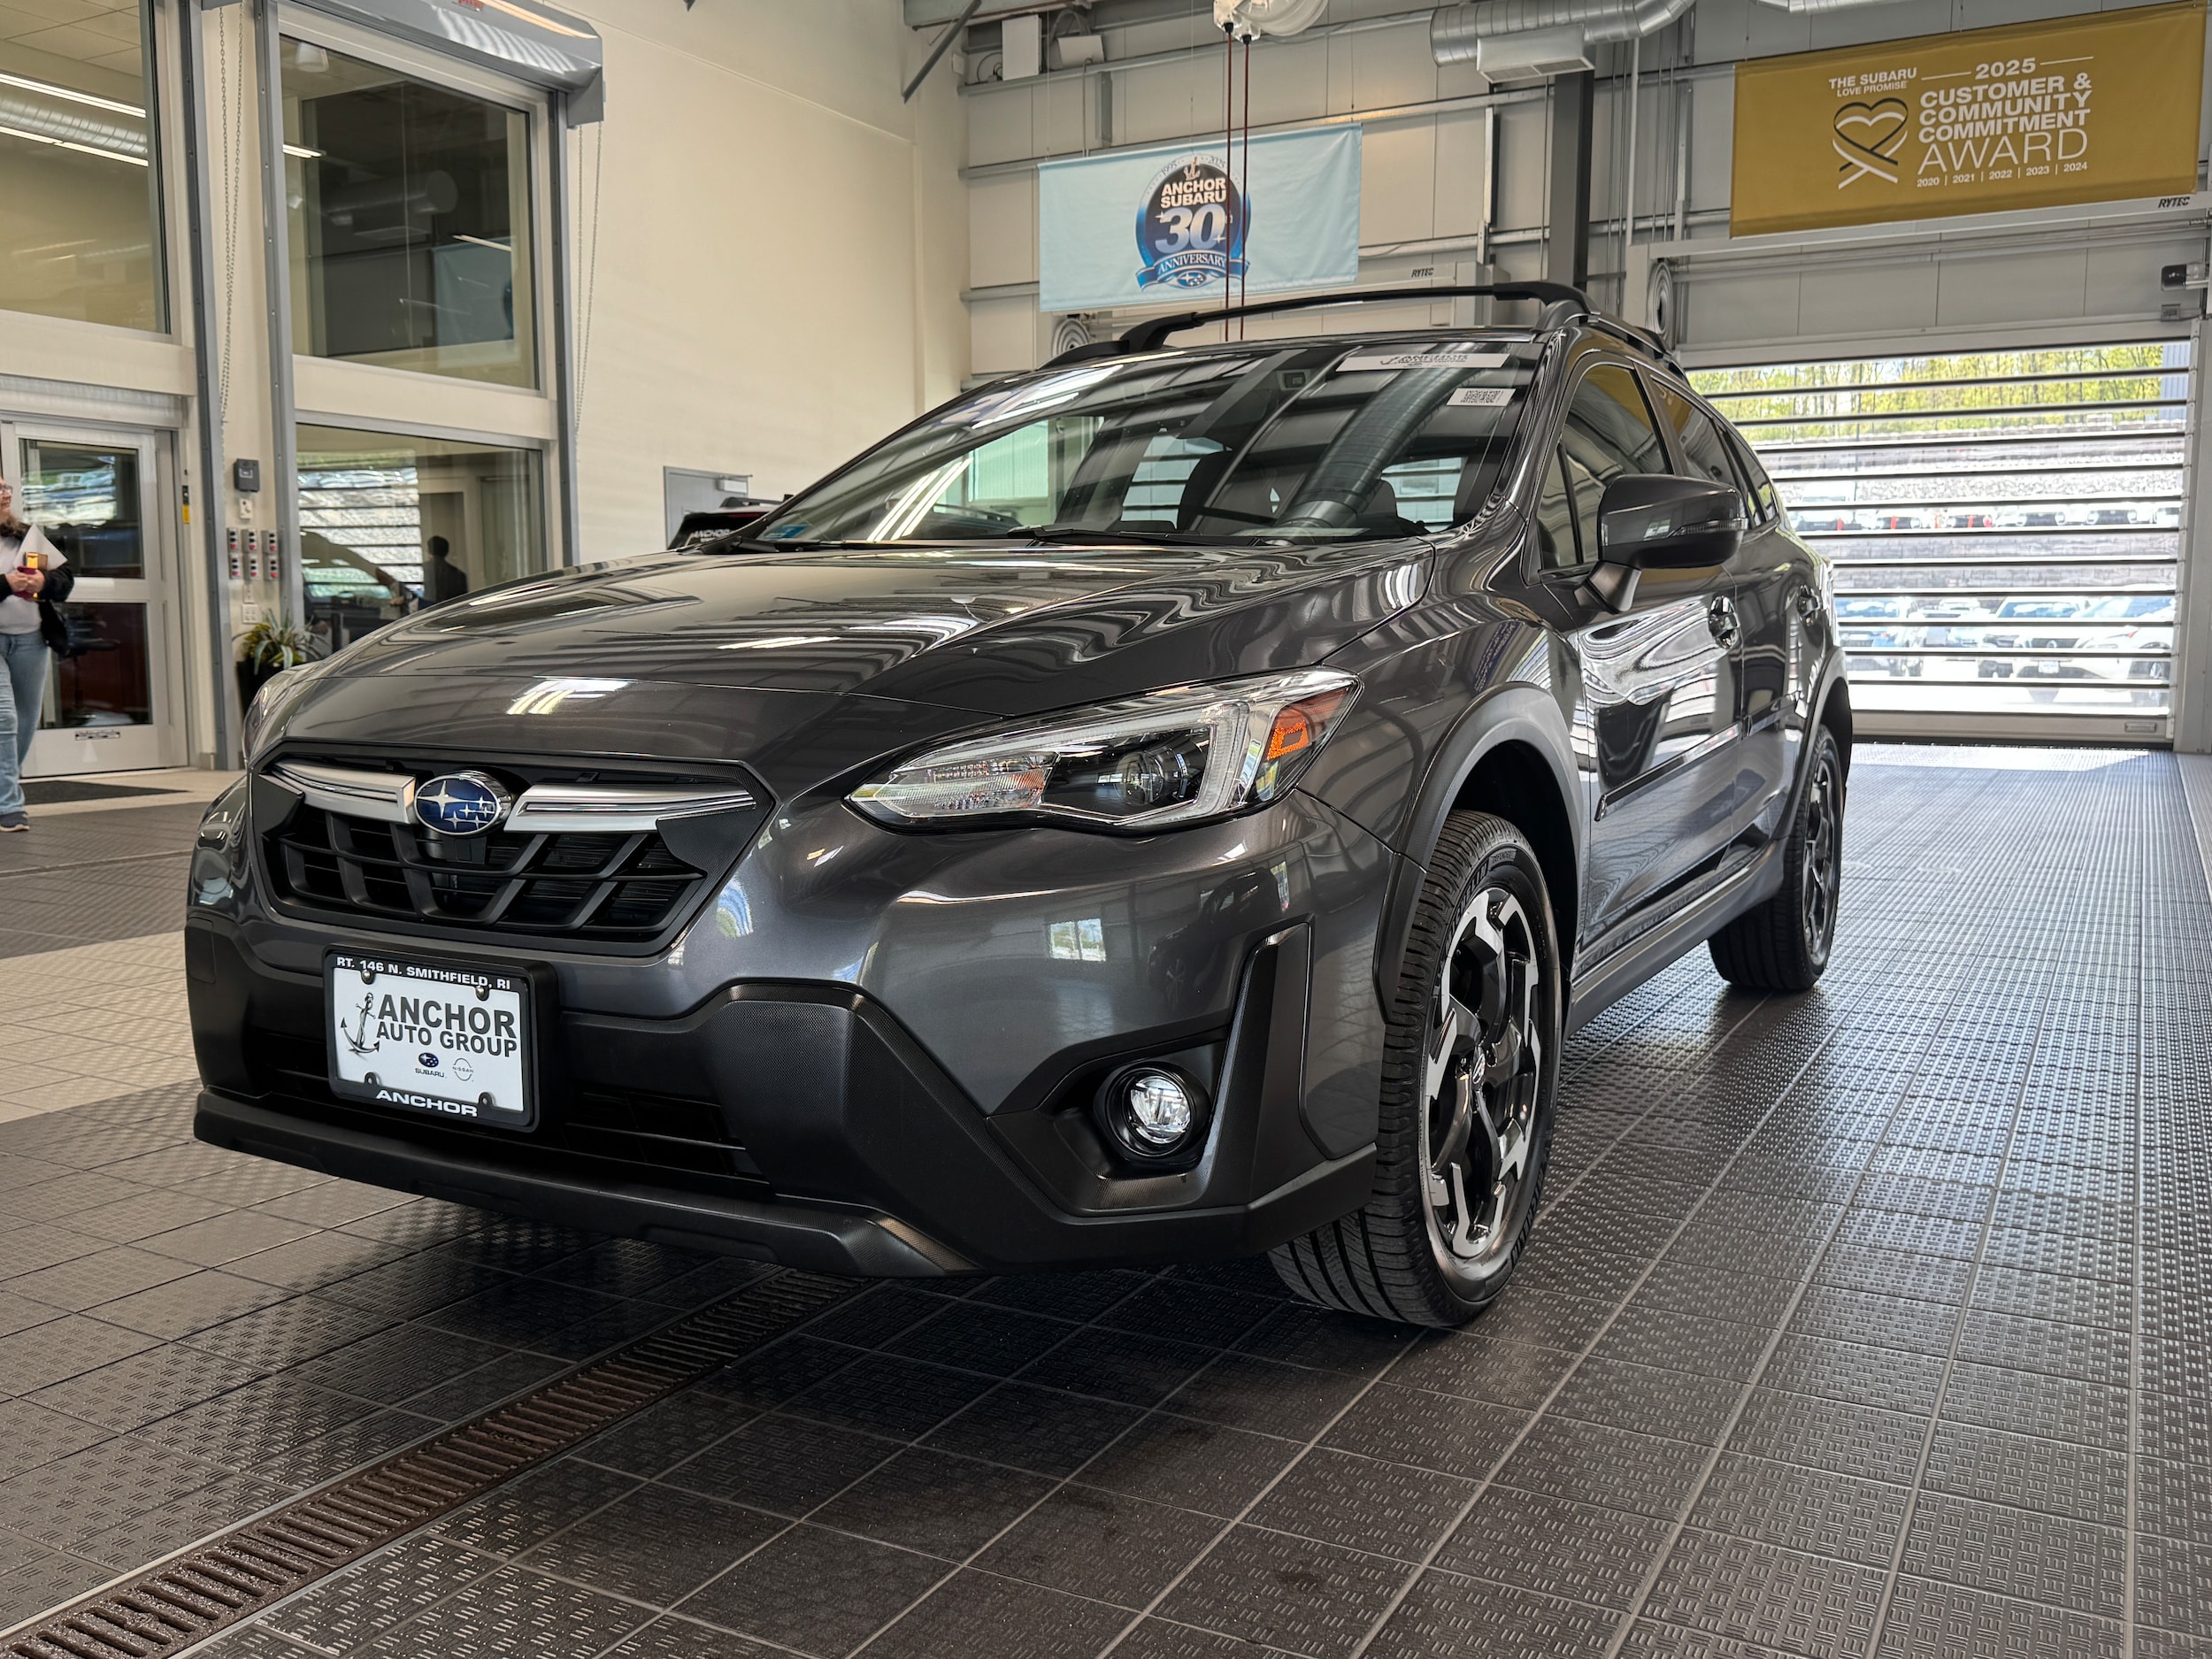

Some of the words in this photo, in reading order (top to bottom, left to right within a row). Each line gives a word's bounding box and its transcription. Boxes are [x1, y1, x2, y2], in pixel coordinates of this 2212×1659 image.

[1829, 75, 1856, 89] THE
[1860, 67, 1916, 85] SUBARU
[1975, 58, 2036, 80] 2025
[1837, 87, 1862, 97] LOVE
[1863, 81, 1907, 94] PROMISE
[1920, 75, 2064, 108] CUSTOMER
[2073, 73, 2092, 89] &
[1919, 90, 2092, 126] COMMUNITY
[1918, 109, 2091, 143] COMMITMENT
[1917, 128, 2088, 175] AWARD
[1162, 178, 1226, 196] ANCHOR
[1916, 176, 1939, 187] 2020
[1953, 173, 1975, 184] 2021
[1989, 169, 2012, 180] 2022
[2026, 165, 2050, 176] 2023
[2063, 161, 2087, 173] 2024
[1160, 189, 1226, 208] SUBARU
[2158, 196, 2190, 208] RYTEC
[1157, 253, 1227, 274] ANNIVERSARY
[336, 956, 355, 968] RT.
[359, 960, 384, 972] 146
[388, 964, 403, 975] N.
[406, 966, 493, 988] SMITHFIELD,
[496, 979, 511, 989] RI
[378, 994, 517, 1039] ANCHOR
[376, 1021, 433, 1046] AUTO
[440, 1031, 518, 1057] GROUP
[415, 1067, 445, 1078] SUBARU
[375, 1089, 479, 1117] ANCHOR
